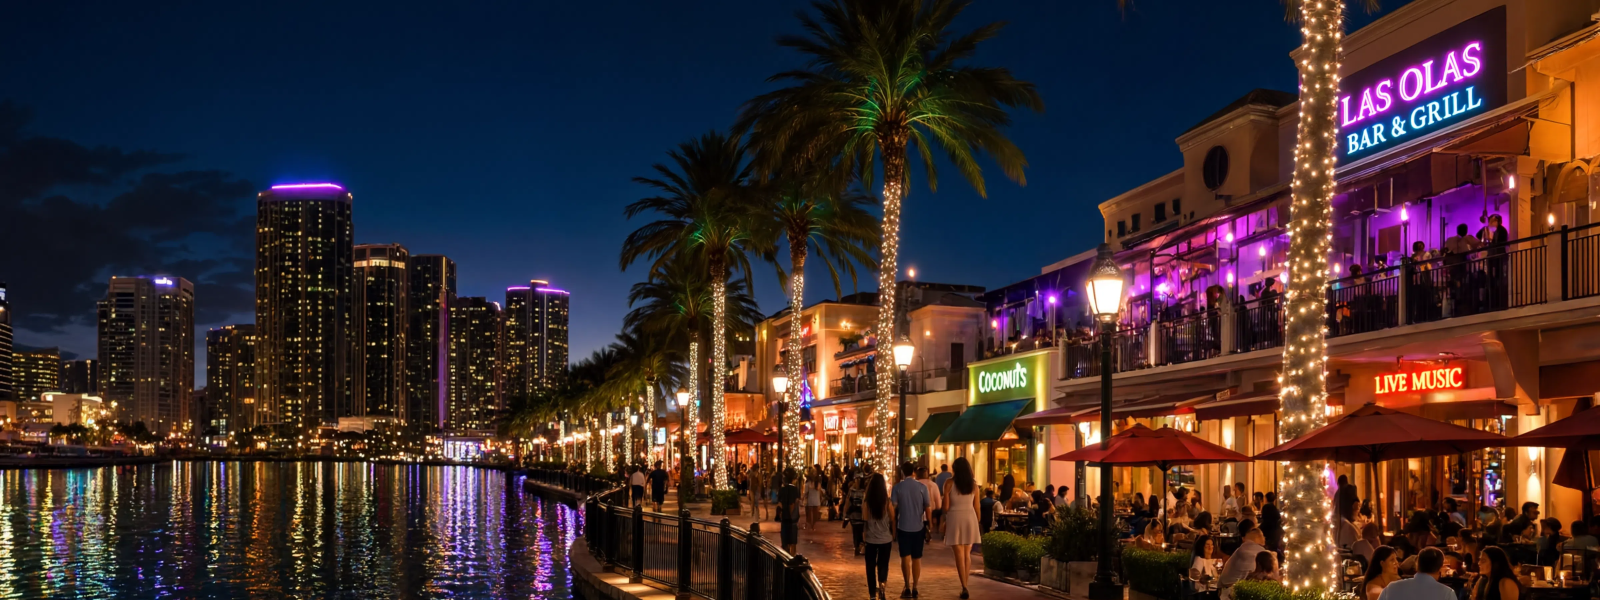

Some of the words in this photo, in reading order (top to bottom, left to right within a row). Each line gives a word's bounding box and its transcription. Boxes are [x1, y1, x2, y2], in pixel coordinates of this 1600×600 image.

[1341, 80, 1393, 128] LAS
[1399, 42, 1481, 102] OLAS
[1347, 123, 1387, 155] BAR
[1391, 115, 1407, 138] &
[1410, 86, 1482, 130] GRILL
[1374, 373, 1408, 394] LIVE
[1411, 367, 1463, 391] MUSIC
